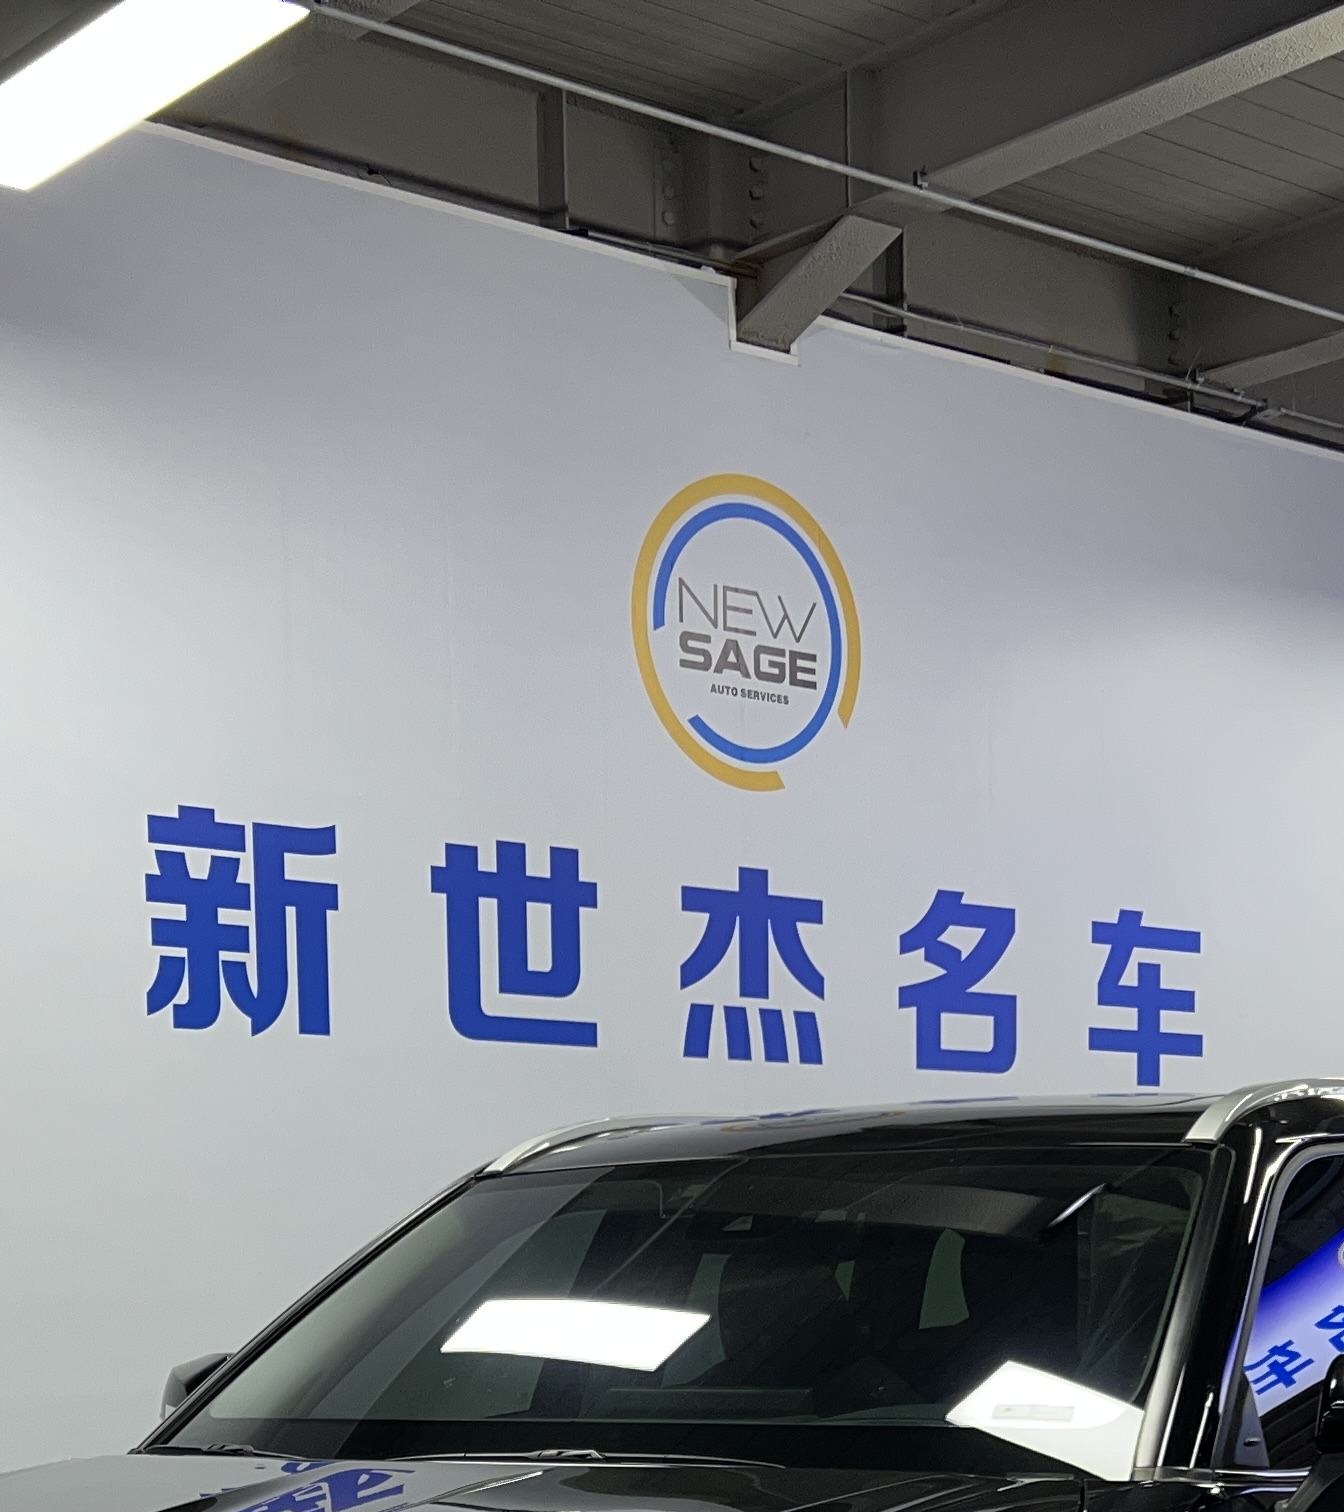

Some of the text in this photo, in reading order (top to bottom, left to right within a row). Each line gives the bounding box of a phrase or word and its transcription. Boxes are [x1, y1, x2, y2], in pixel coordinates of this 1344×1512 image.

[677, 577, 817, 643] NEW
[678, 630, 817, 690] SAGE
[710, 683, 789, 705] AUTO SERVICES
[145, 804, 1204, 1086] 新世杰名车
